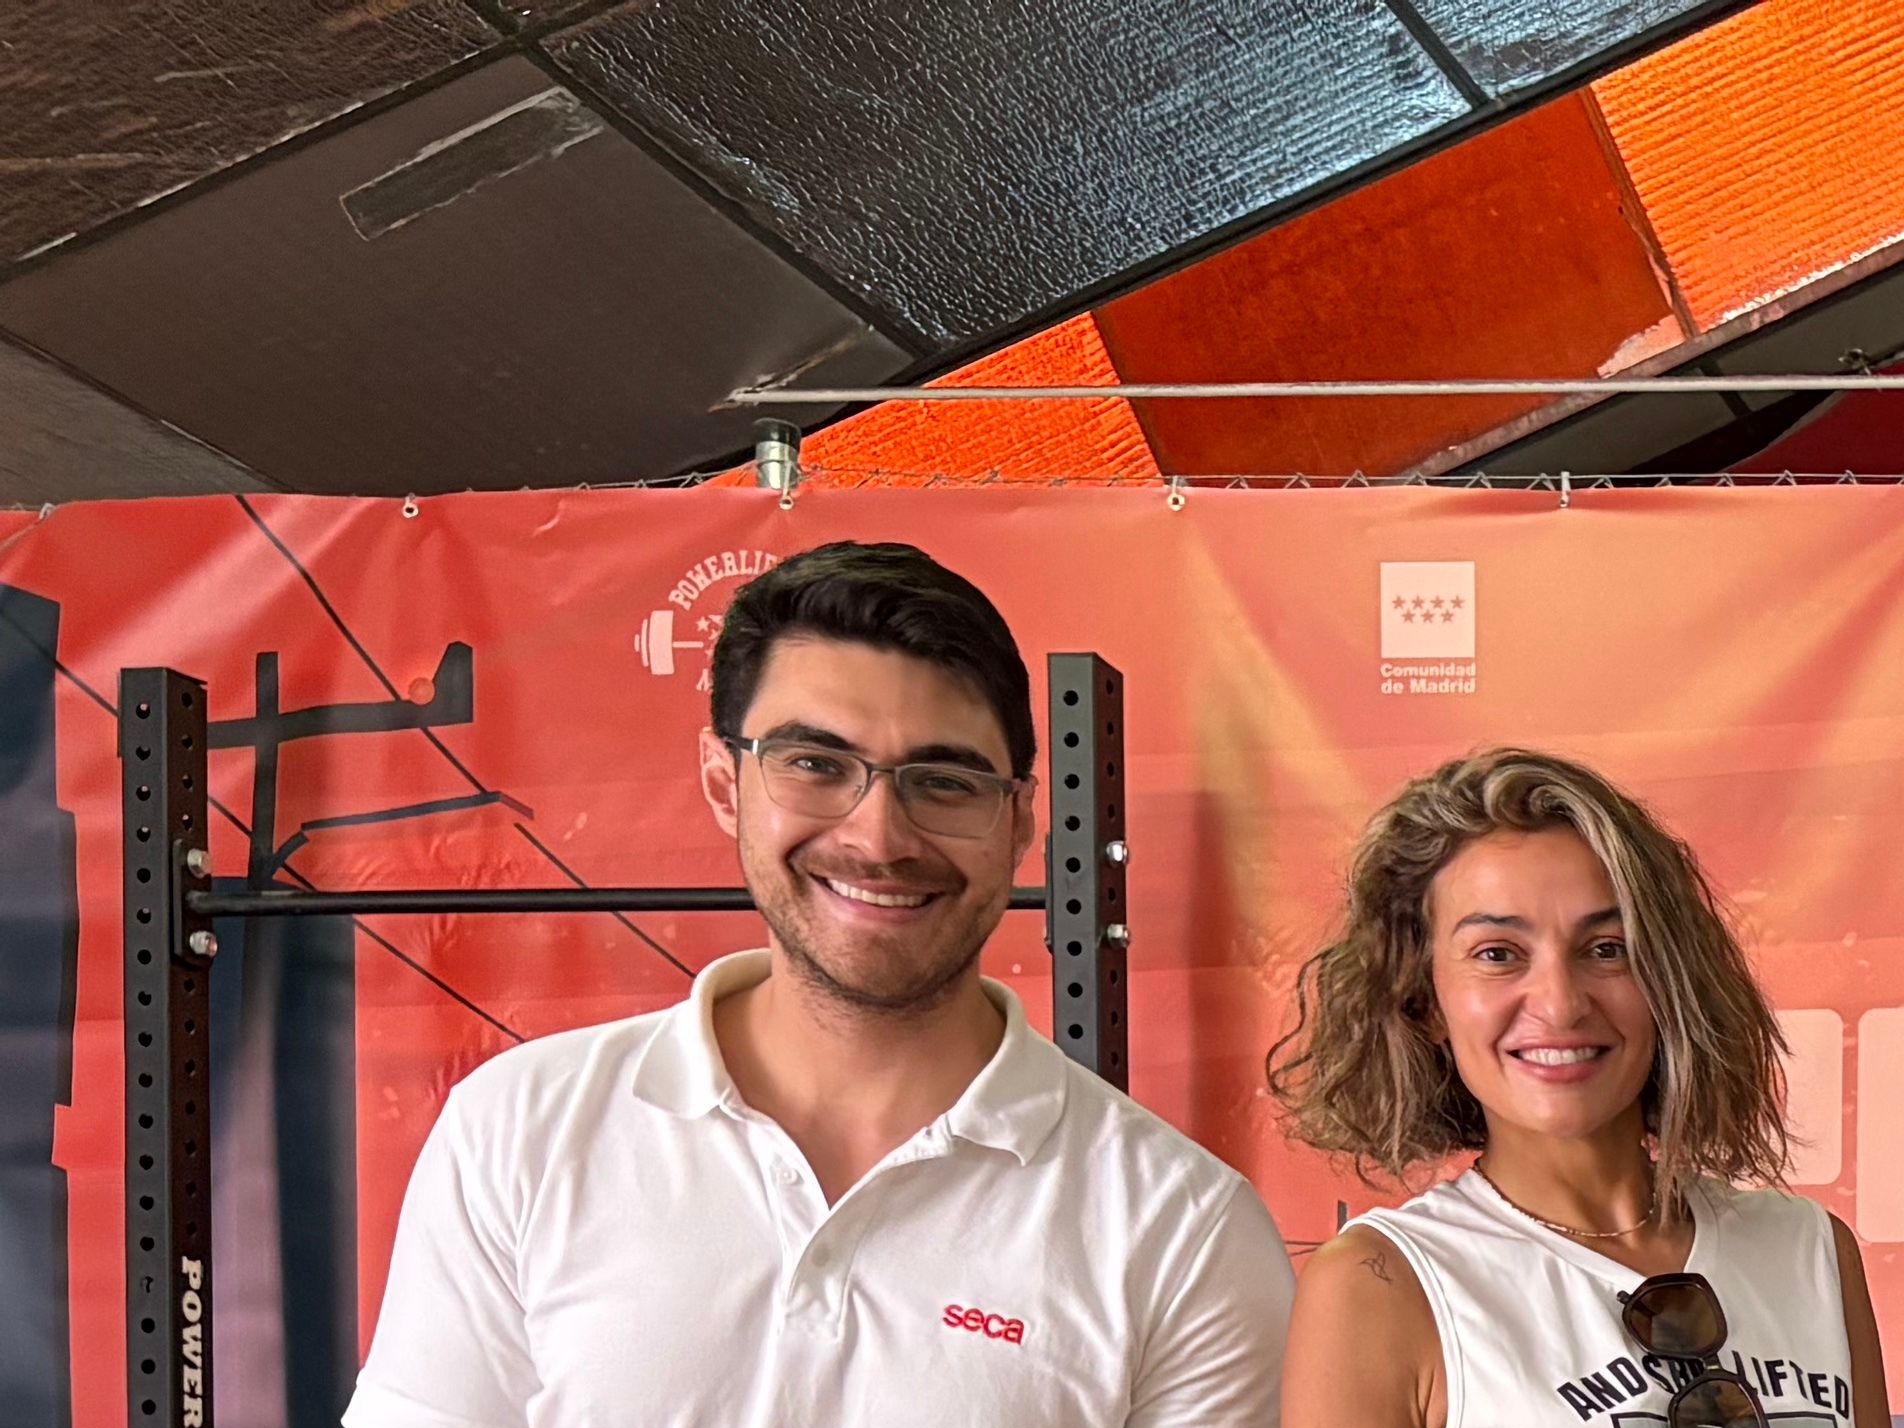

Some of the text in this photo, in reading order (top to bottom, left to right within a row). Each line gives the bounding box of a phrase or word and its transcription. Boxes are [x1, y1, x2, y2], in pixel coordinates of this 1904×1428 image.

[1380, 662, 1476, 678] Comunidad
[1381, 678, 1476, 694] de Madrid
[943, 1304, 1024, 1345] seca
[1557, 1356, 1650, 1422] AND
